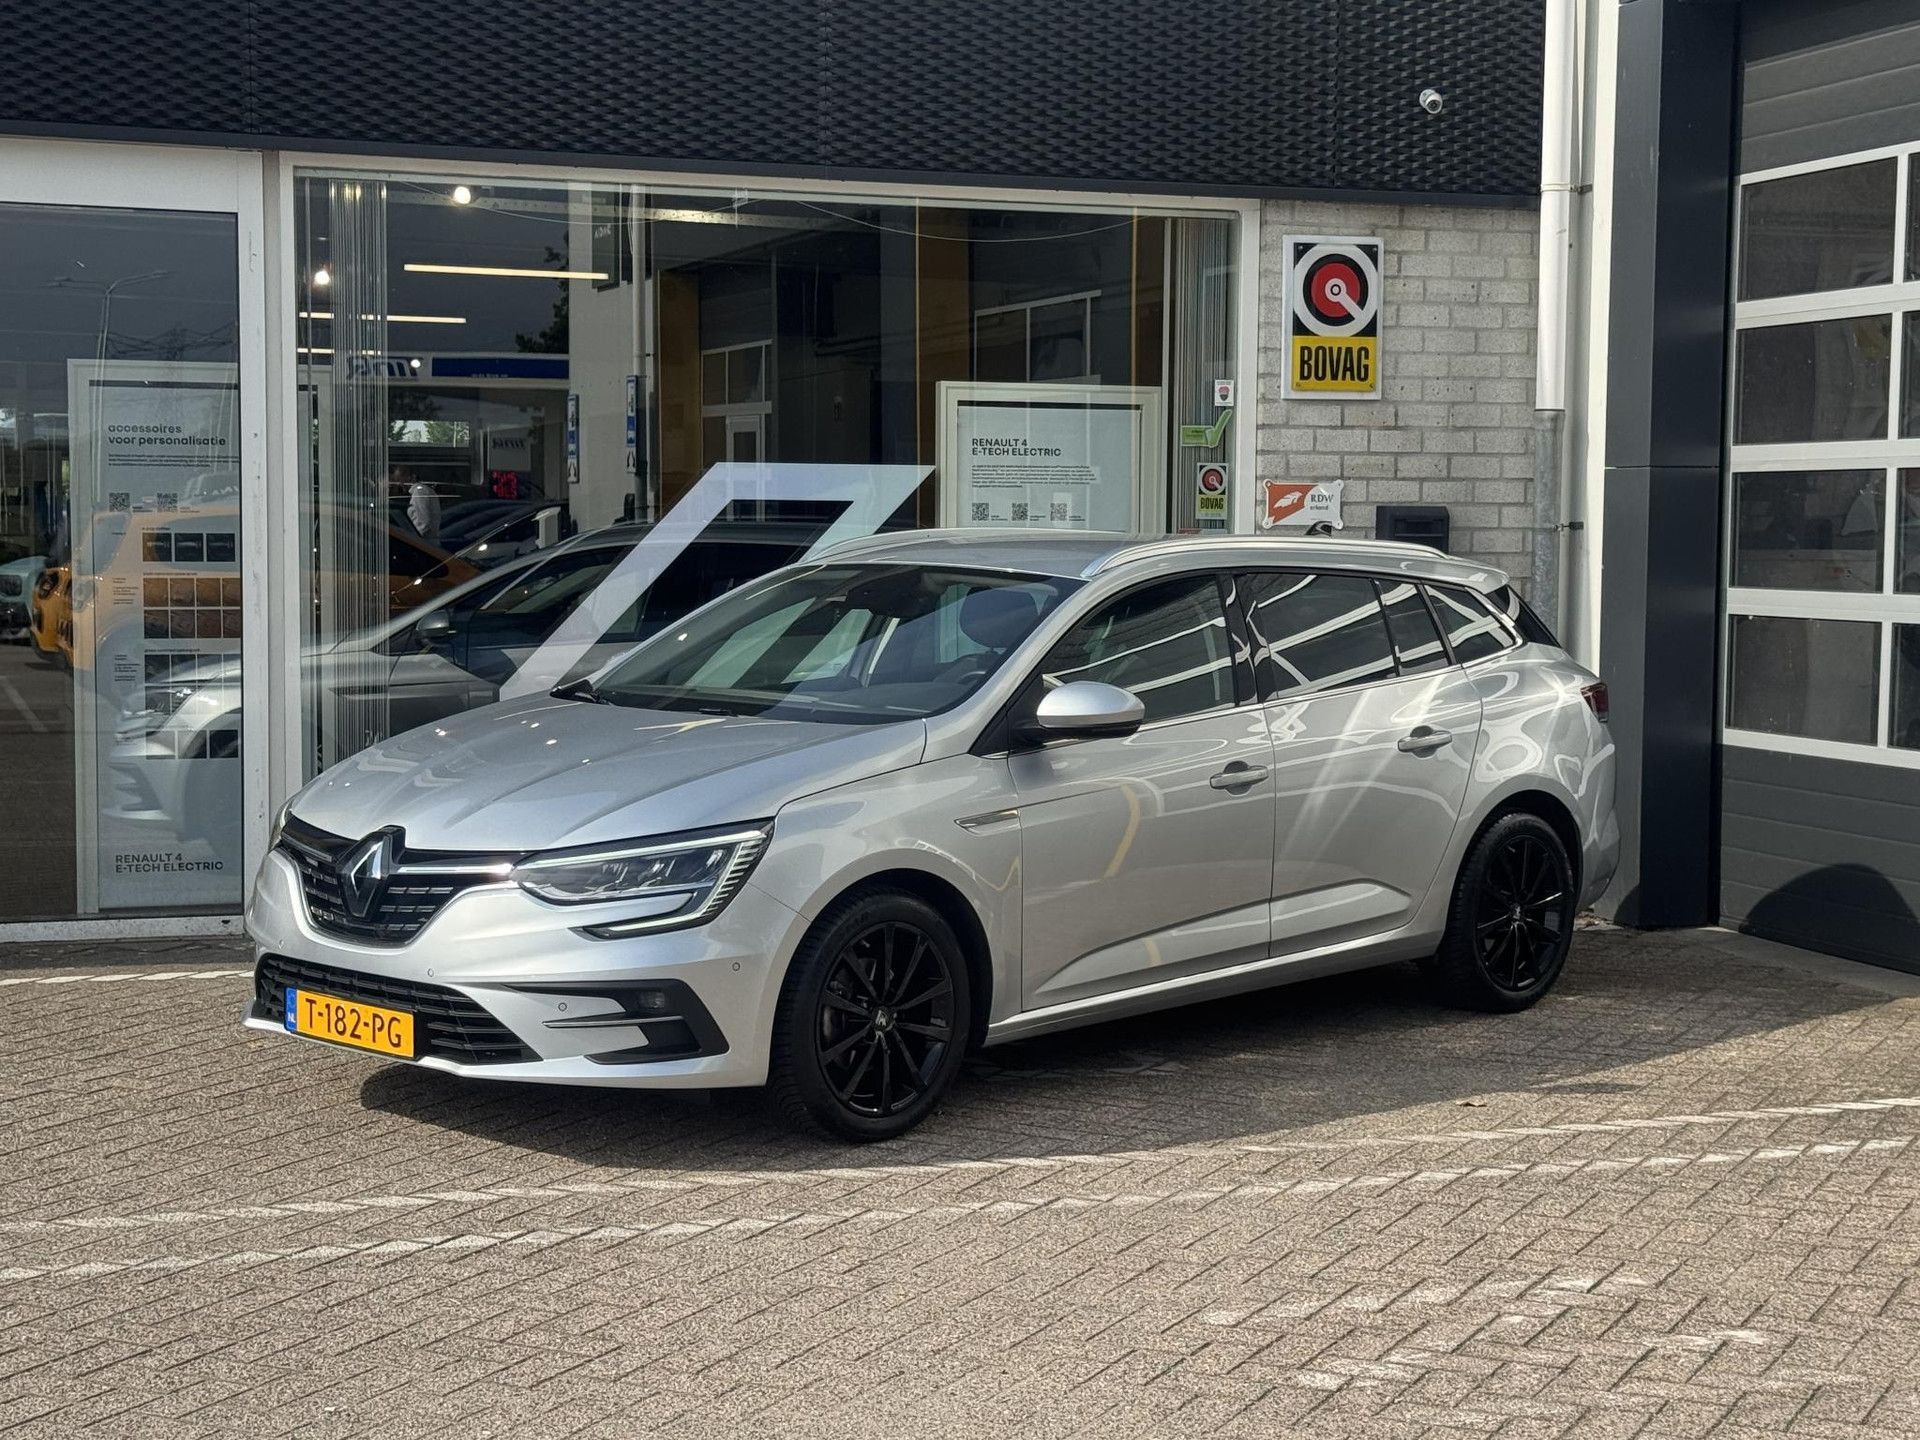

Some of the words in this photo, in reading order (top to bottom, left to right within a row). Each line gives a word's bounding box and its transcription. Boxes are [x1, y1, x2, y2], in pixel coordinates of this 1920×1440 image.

[1299, 345, 1370, 382] BOVAG
[108, 423, 182, 434] accessoires
[108, 436, 136, 445] voor
[138, 435, 226, 447] personalisatie
[971, 438, 1020, 447] RENAULT
[1021, 438, 1028, 447] 4
[971, 447, 1010, 456] E-TECH
[1011, 447, 1062, 457] ELECTRIC
[1200, 497, 1224, 510] BOVAG
[1310, 494, 1334, 503] RDW
[115, 853, 173, 864] RENAULT
[174, 853, 182, 863] 4
[115, 864, 160, 874] E-TECH
[163, 861, 224, 872] ELECTRIC
[287, 1011, 297, 1023] NL
[304, 997, 402, 1048] T-182-PG
